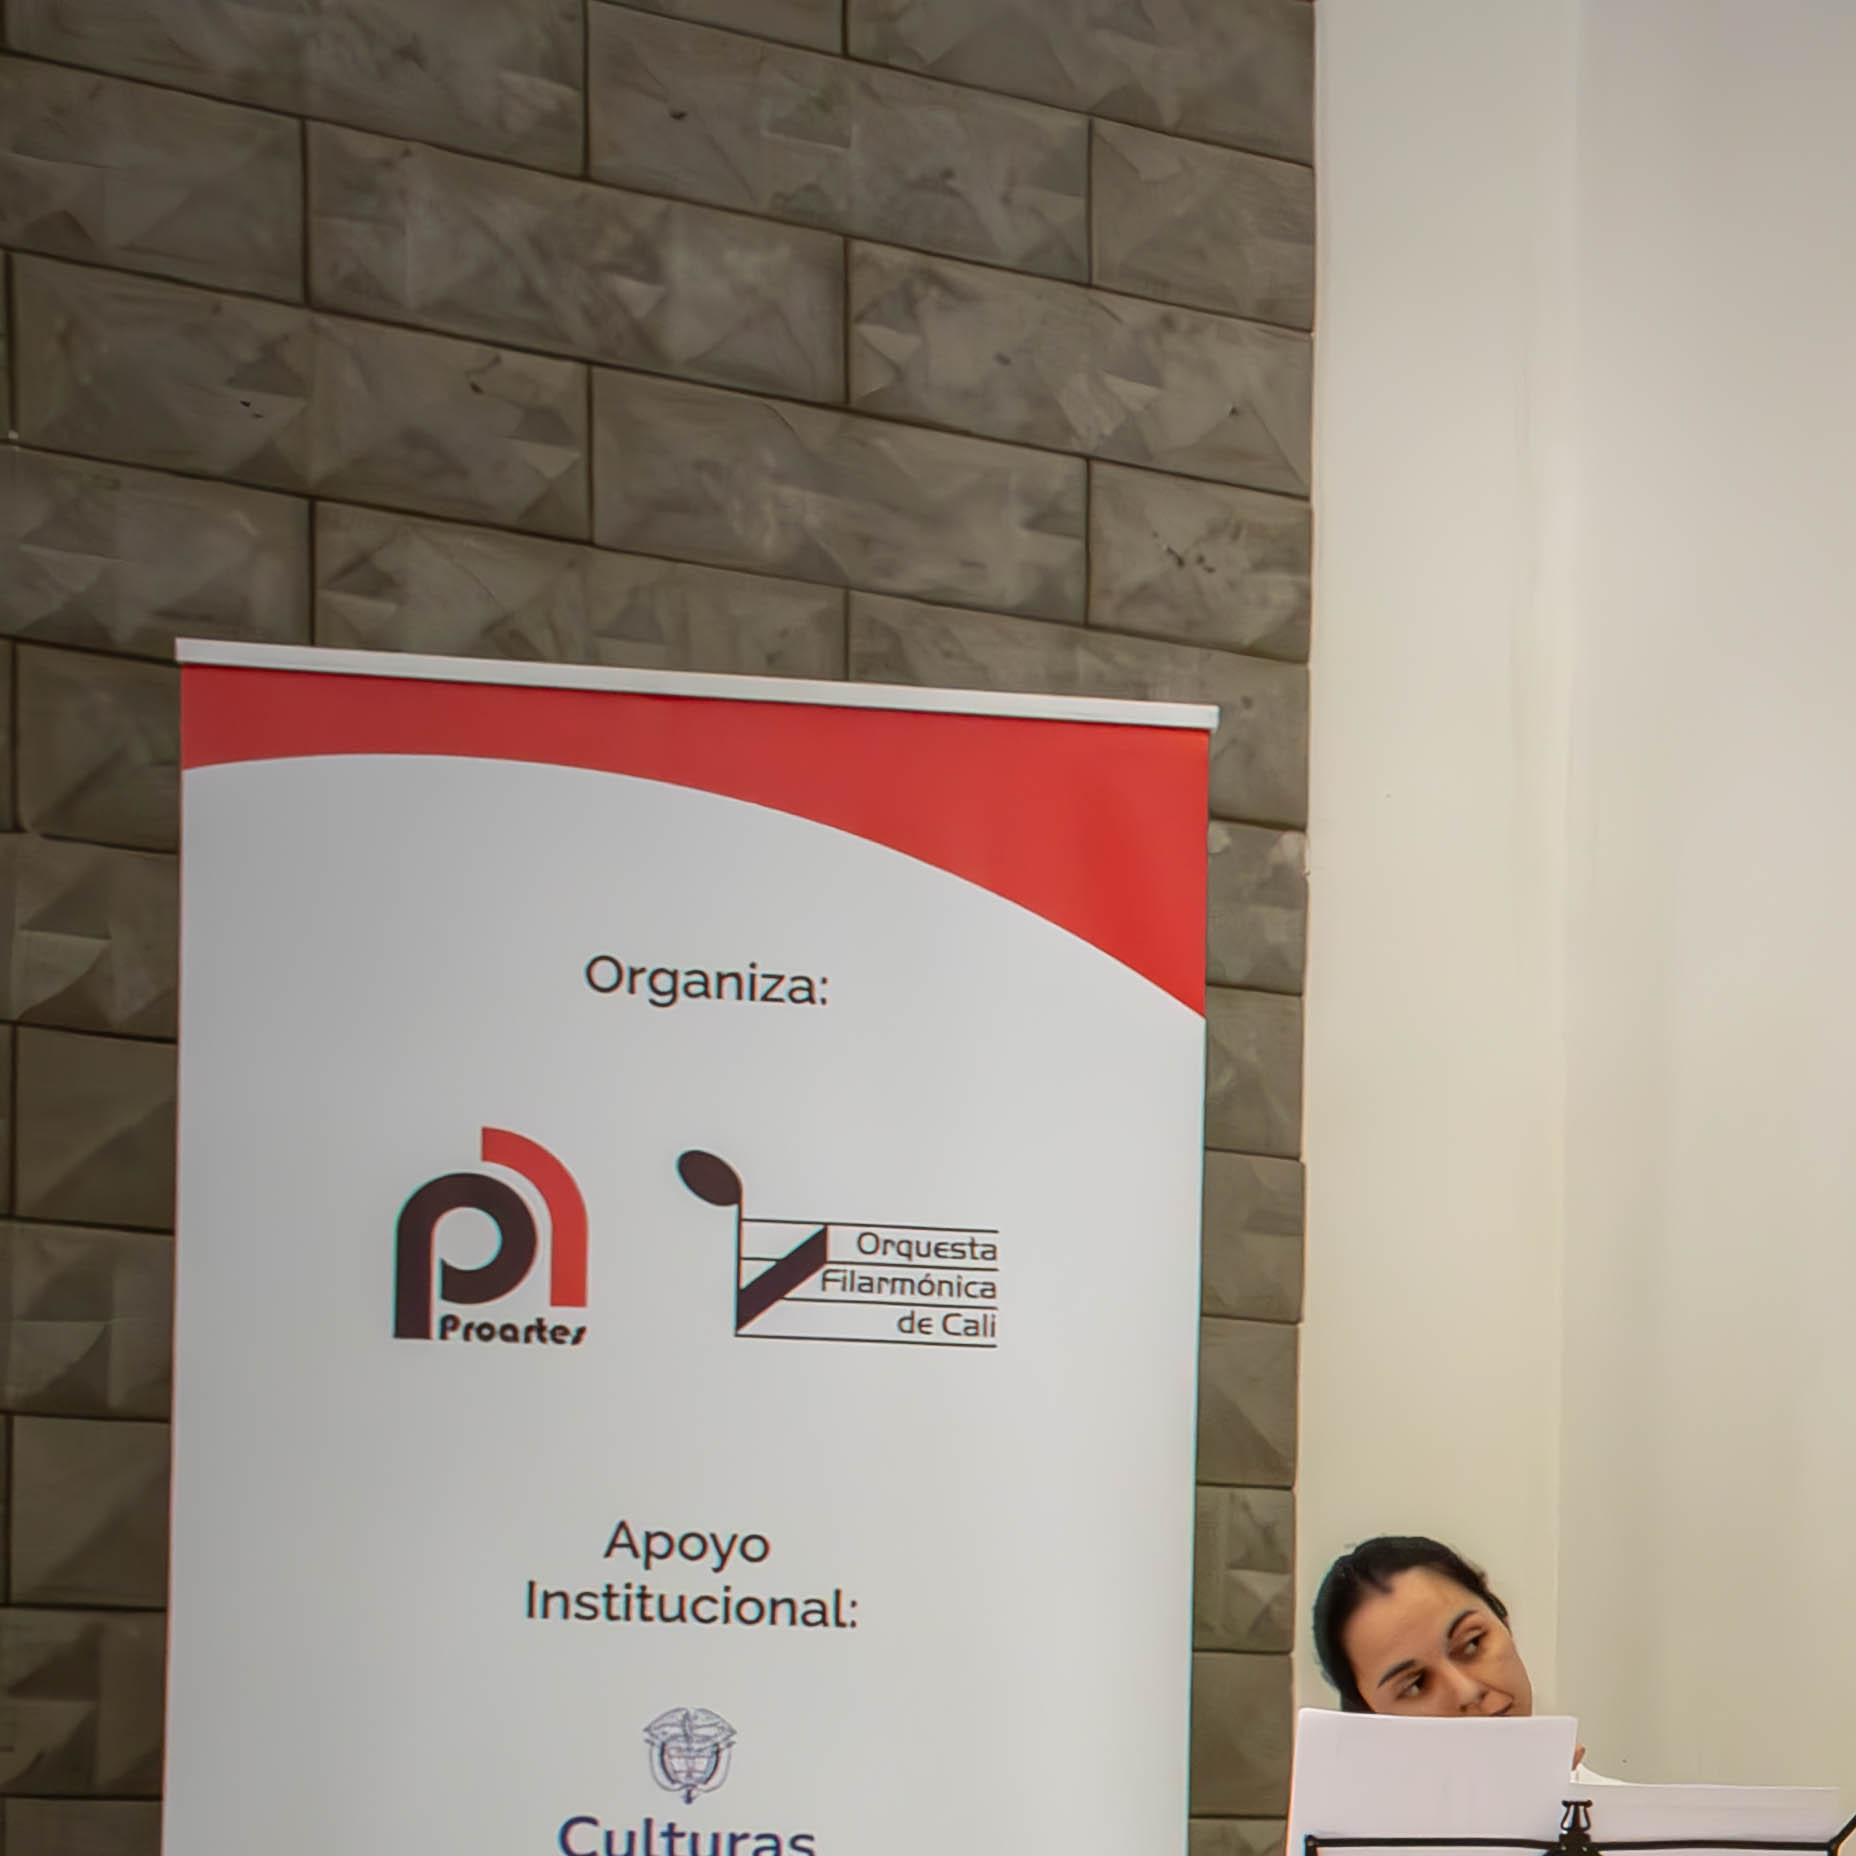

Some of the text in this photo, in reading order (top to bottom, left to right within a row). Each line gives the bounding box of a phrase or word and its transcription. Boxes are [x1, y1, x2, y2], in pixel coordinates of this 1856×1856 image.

[585, 955, 829, 1007] Organiza:
[857, 1231, 997, 1261] Orquesta
[821, 1268, 997, 1299] Filarmónica
[440, 1314, 588, 1346] Proartes
[897, 1310, 996, 1338] de Cali
[603, 1520, 770, 1572] Apoyo
[524, 1580, 858, 1629] Institucional:
